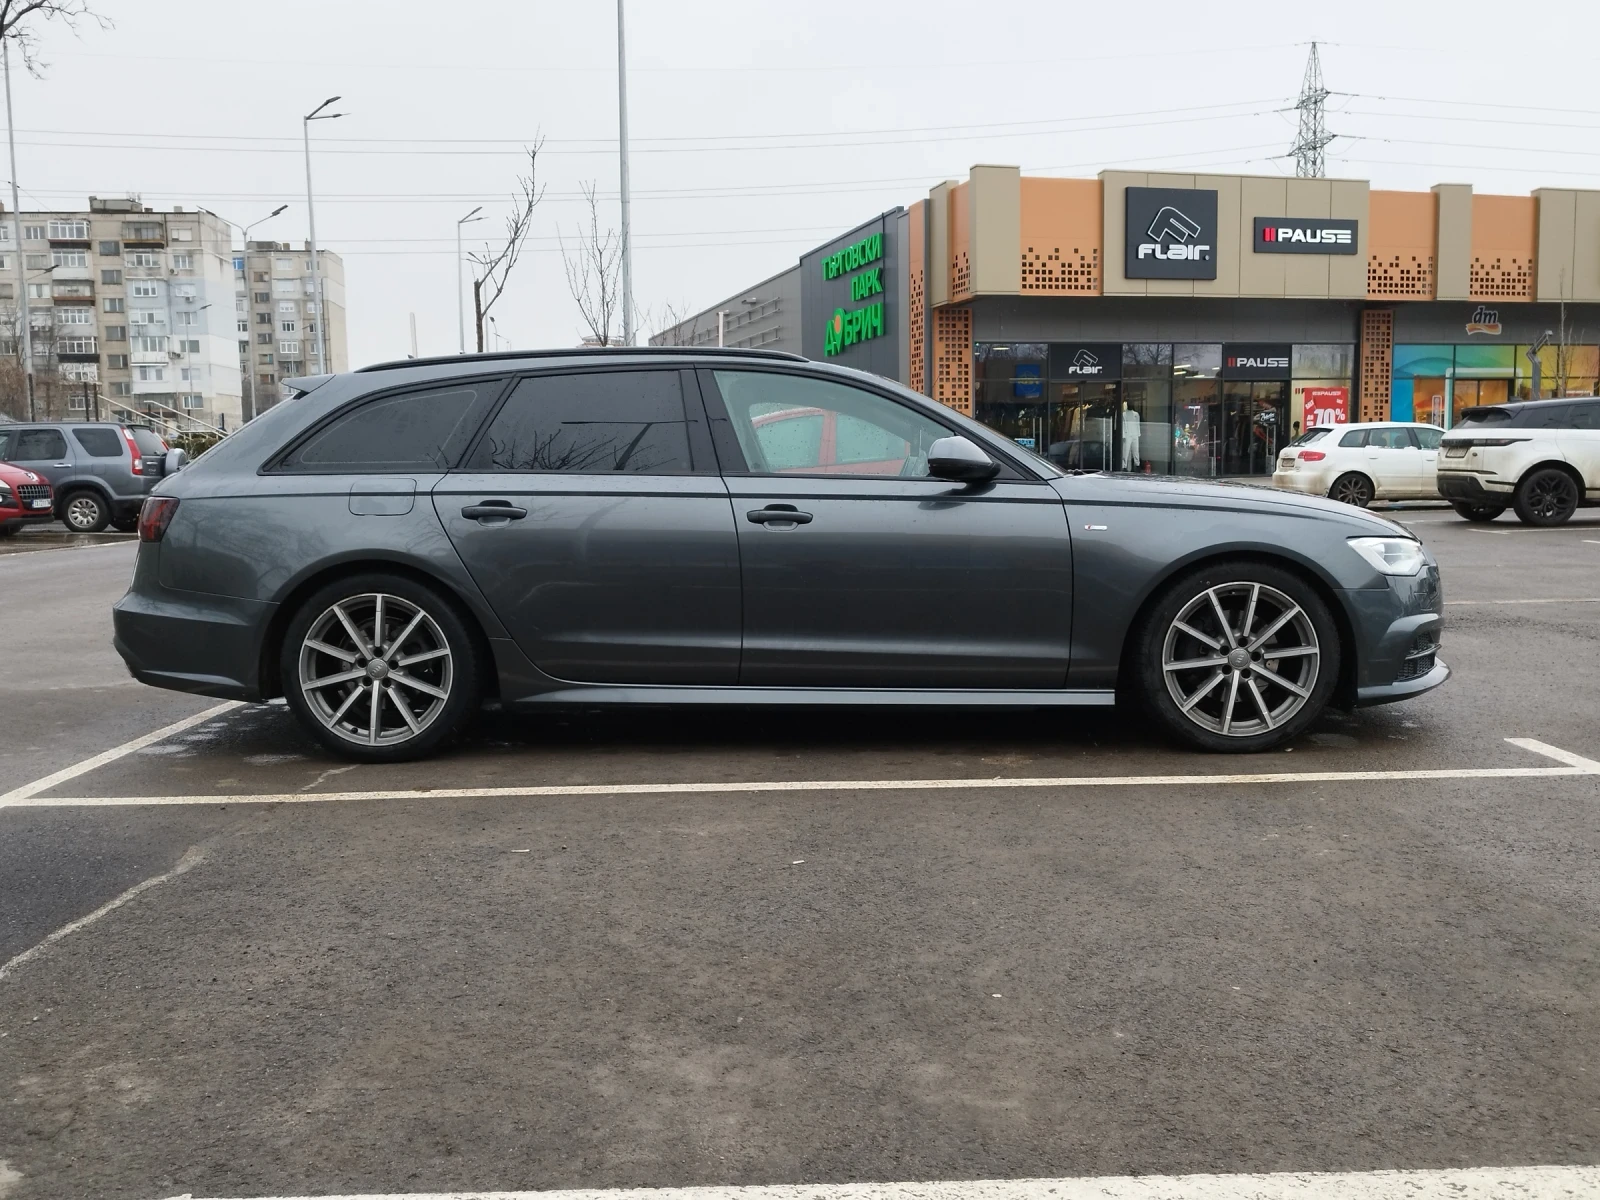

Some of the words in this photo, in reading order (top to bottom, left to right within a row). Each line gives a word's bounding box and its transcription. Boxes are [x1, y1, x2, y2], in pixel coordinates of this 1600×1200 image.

[1277, 228, 1352, 243] PAUSE
[821, 232, 883, 281] ТЪРГОВСКИ
[850, 267, 883, 301] ПАРК
[1473, 306, 1498, 324] dm
[824, 302, 884, 357] ДОБРИЧ
[1236, 357, 1289, 367] PAUSE
[1314, 408, 1346, 427] 70%
